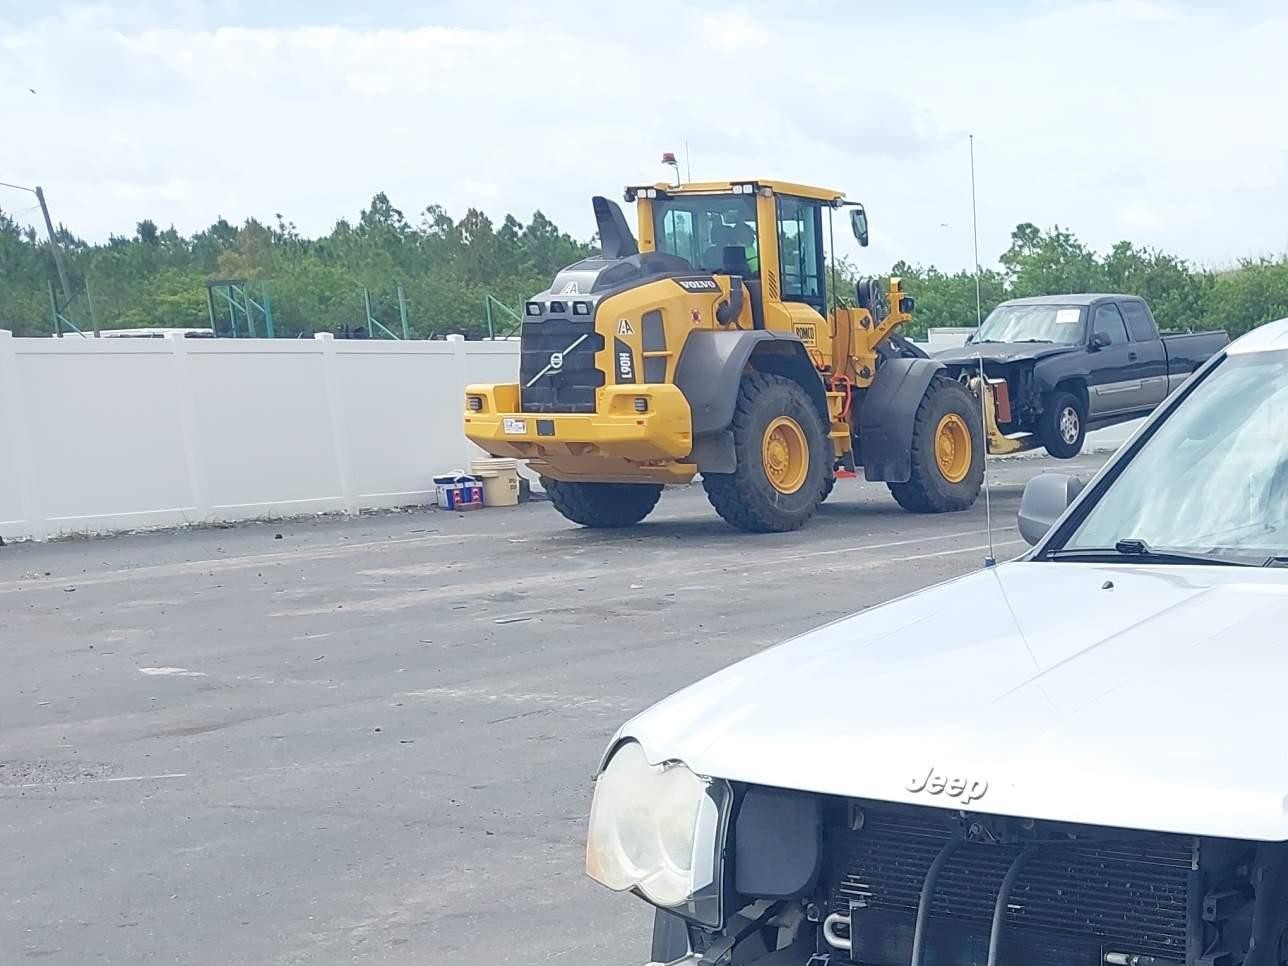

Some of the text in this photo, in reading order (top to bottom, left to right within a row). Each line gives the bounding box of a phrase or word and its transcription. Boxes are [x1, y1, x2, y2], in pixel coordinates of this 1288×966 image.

[680, 280, 717, 290] VOLVO
[618, 351, 633, 379] L90H
[905, 767, 989, 804] Jeep
